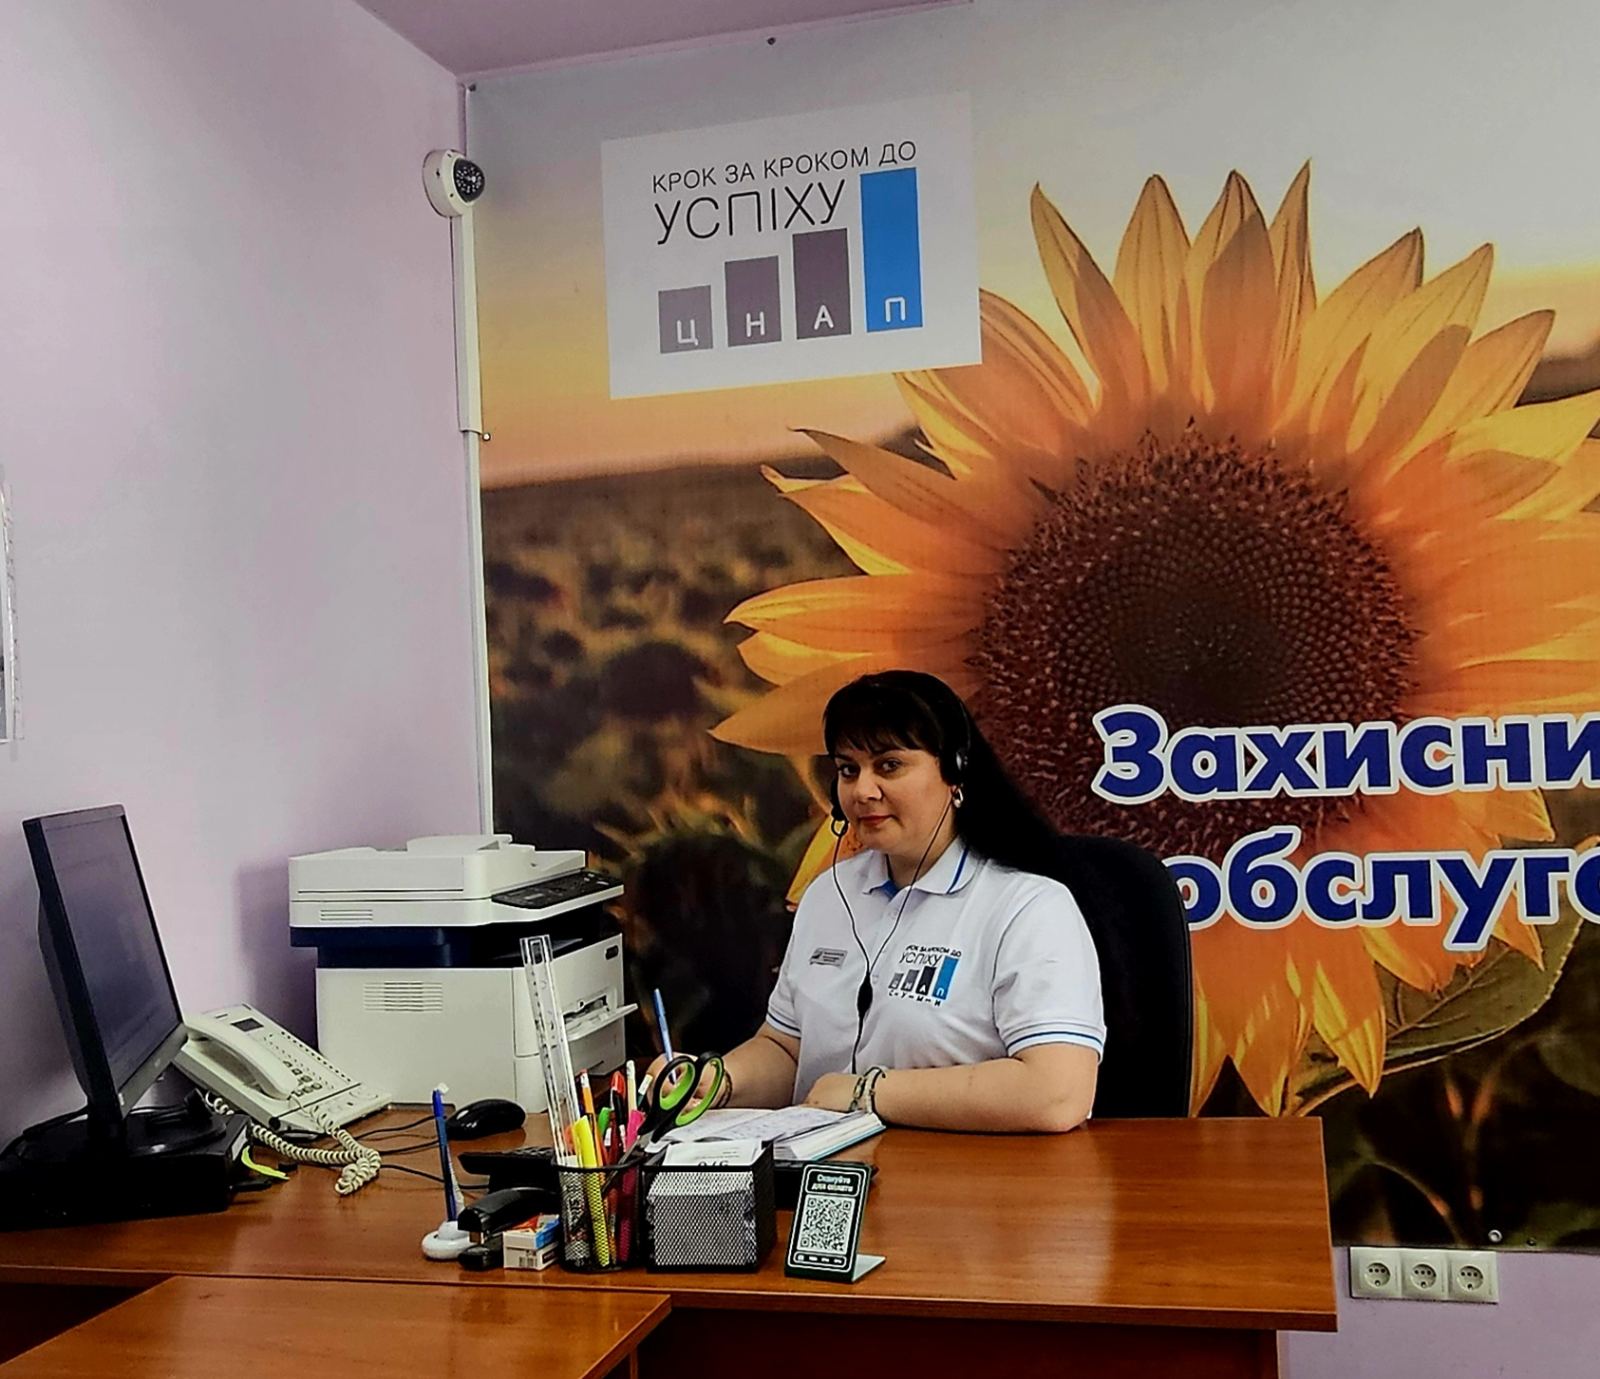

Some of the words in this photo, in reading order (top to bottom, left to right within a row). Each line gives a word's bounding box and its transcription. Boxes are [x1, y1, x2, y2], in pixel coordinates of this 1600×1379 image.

[652, 168, 717, 193] КРОК
[724, 162, 756, 184] ЗА
[763, 147, 869, 179] КРОКОМ
[878, 140, 918, 166] ДО
[654, 179, 846, 245] УСПІХУ
